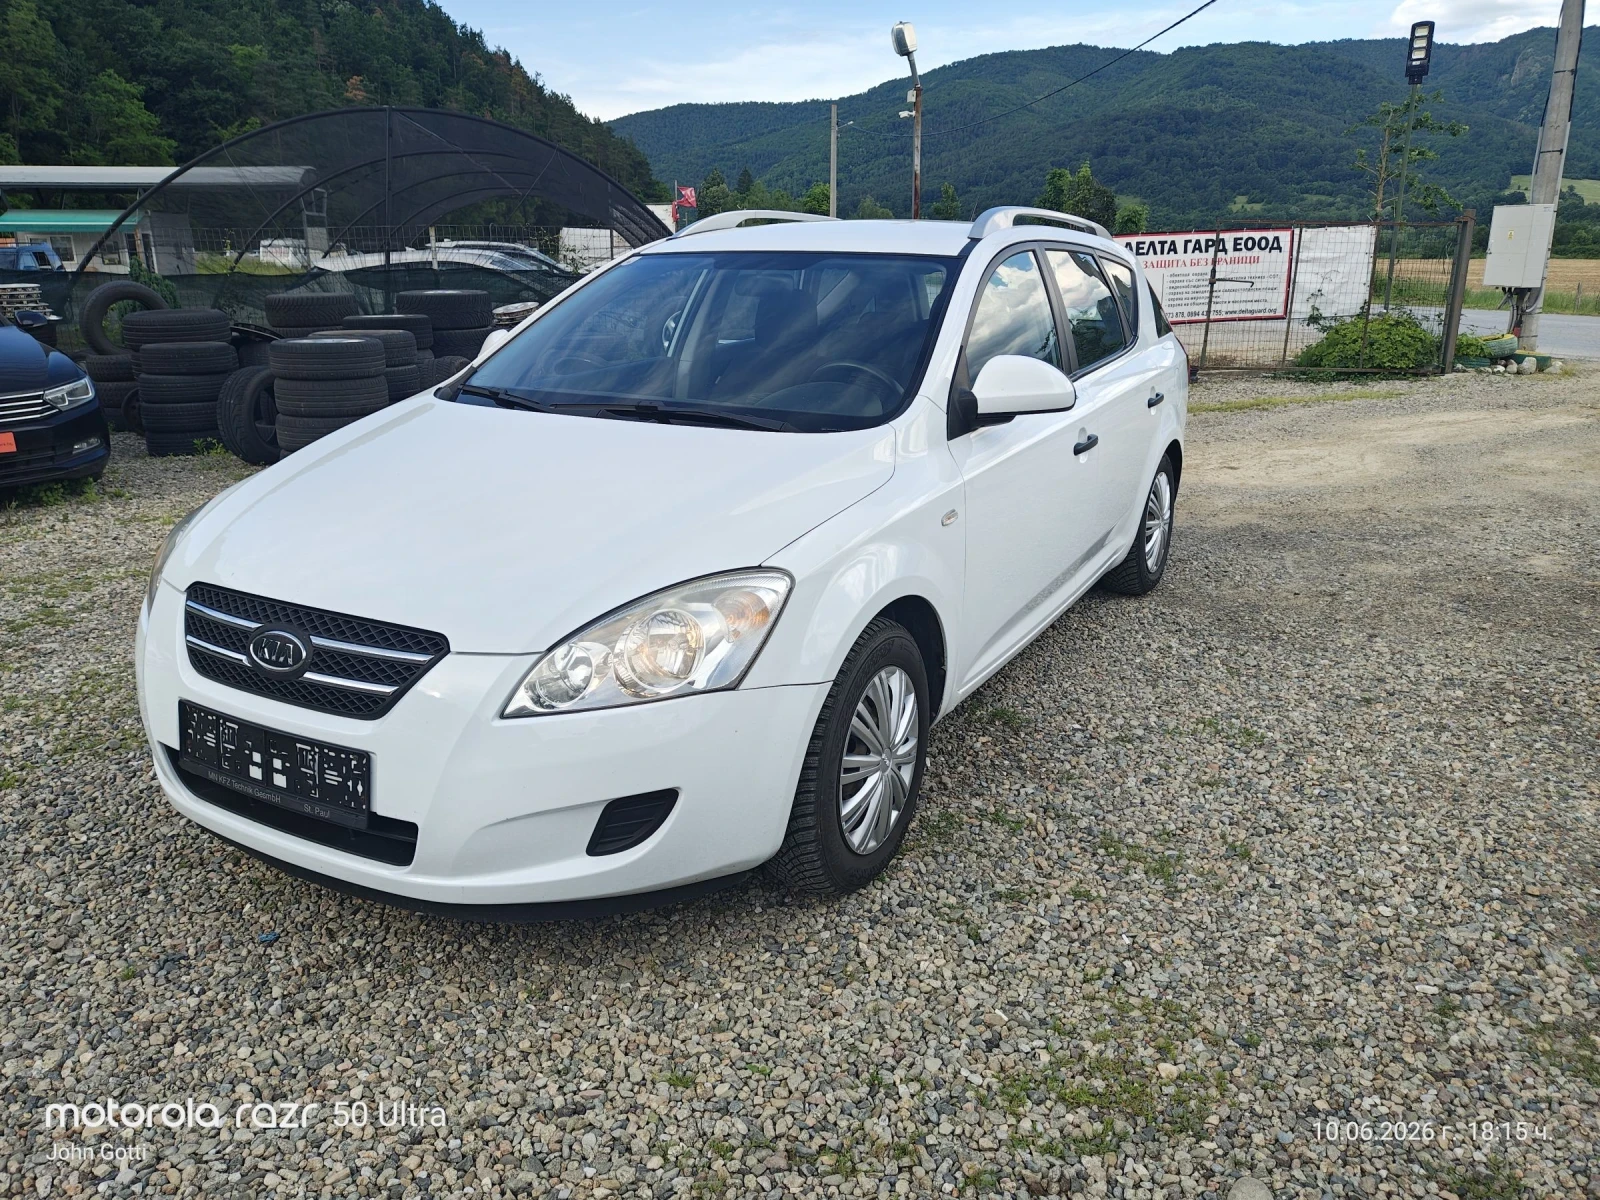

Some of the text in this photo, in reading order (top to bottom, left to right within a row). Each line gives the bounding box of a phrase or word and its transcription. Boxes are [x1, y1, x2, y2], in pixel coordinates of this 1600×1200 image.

[1183, 238, 1228, 255] ГАРД
[1232, 236, 1283, 253] ЕООД
[1143, 259, 1187, 270] ЗАЩИТА
[1189, 258, 1209, 267] БЕЗ
[257, 637, 294, 666] KIA
[232, 780, 254, 794] Technik
[314, 806, 330, 819] Paul
